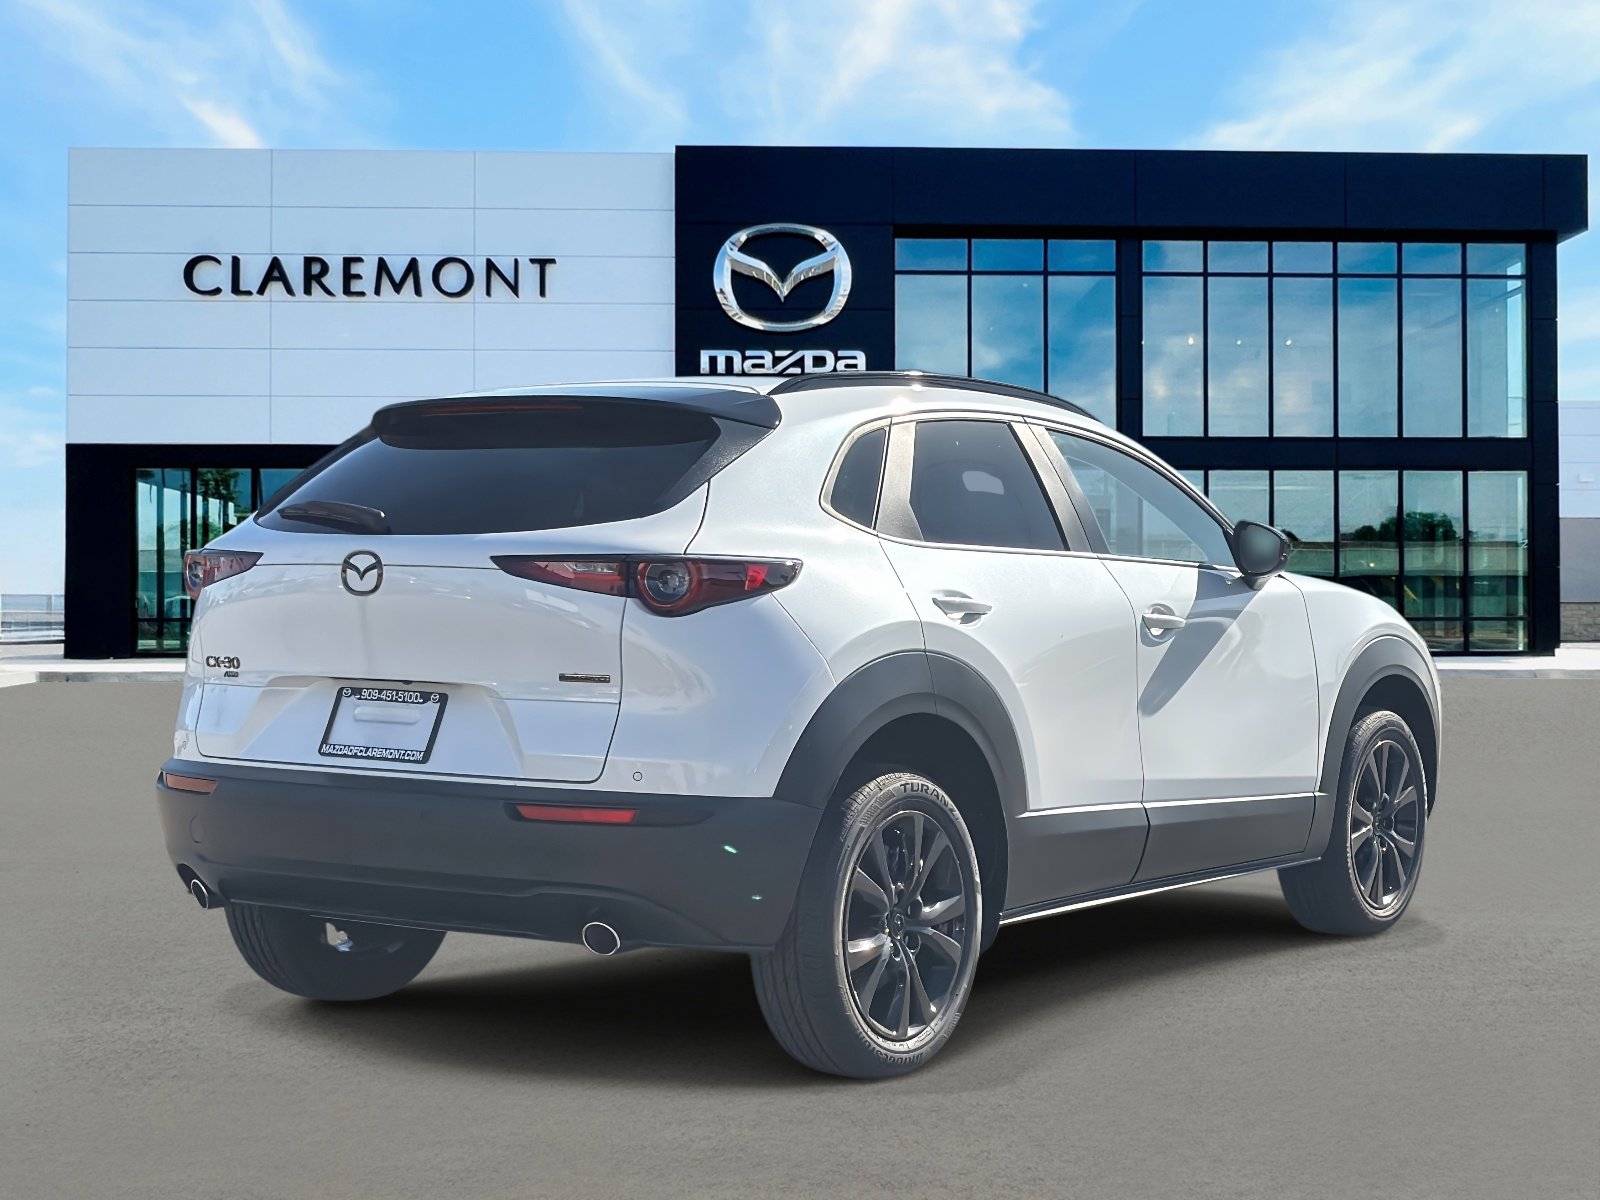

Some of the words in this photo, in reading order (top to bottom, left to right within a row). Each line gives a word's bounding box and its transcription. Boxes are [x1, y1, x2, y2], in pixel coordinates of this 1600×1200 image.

[183, 254, 557, 299] CLAREMONT
[699, 349, 867, 375] mazda
[205, 655, 241, 670] CX-30
[360, 688, 421, 703] 909-451-5100
[321, 743, 425, 761] MAZDAOFCLAREMONT.COM
